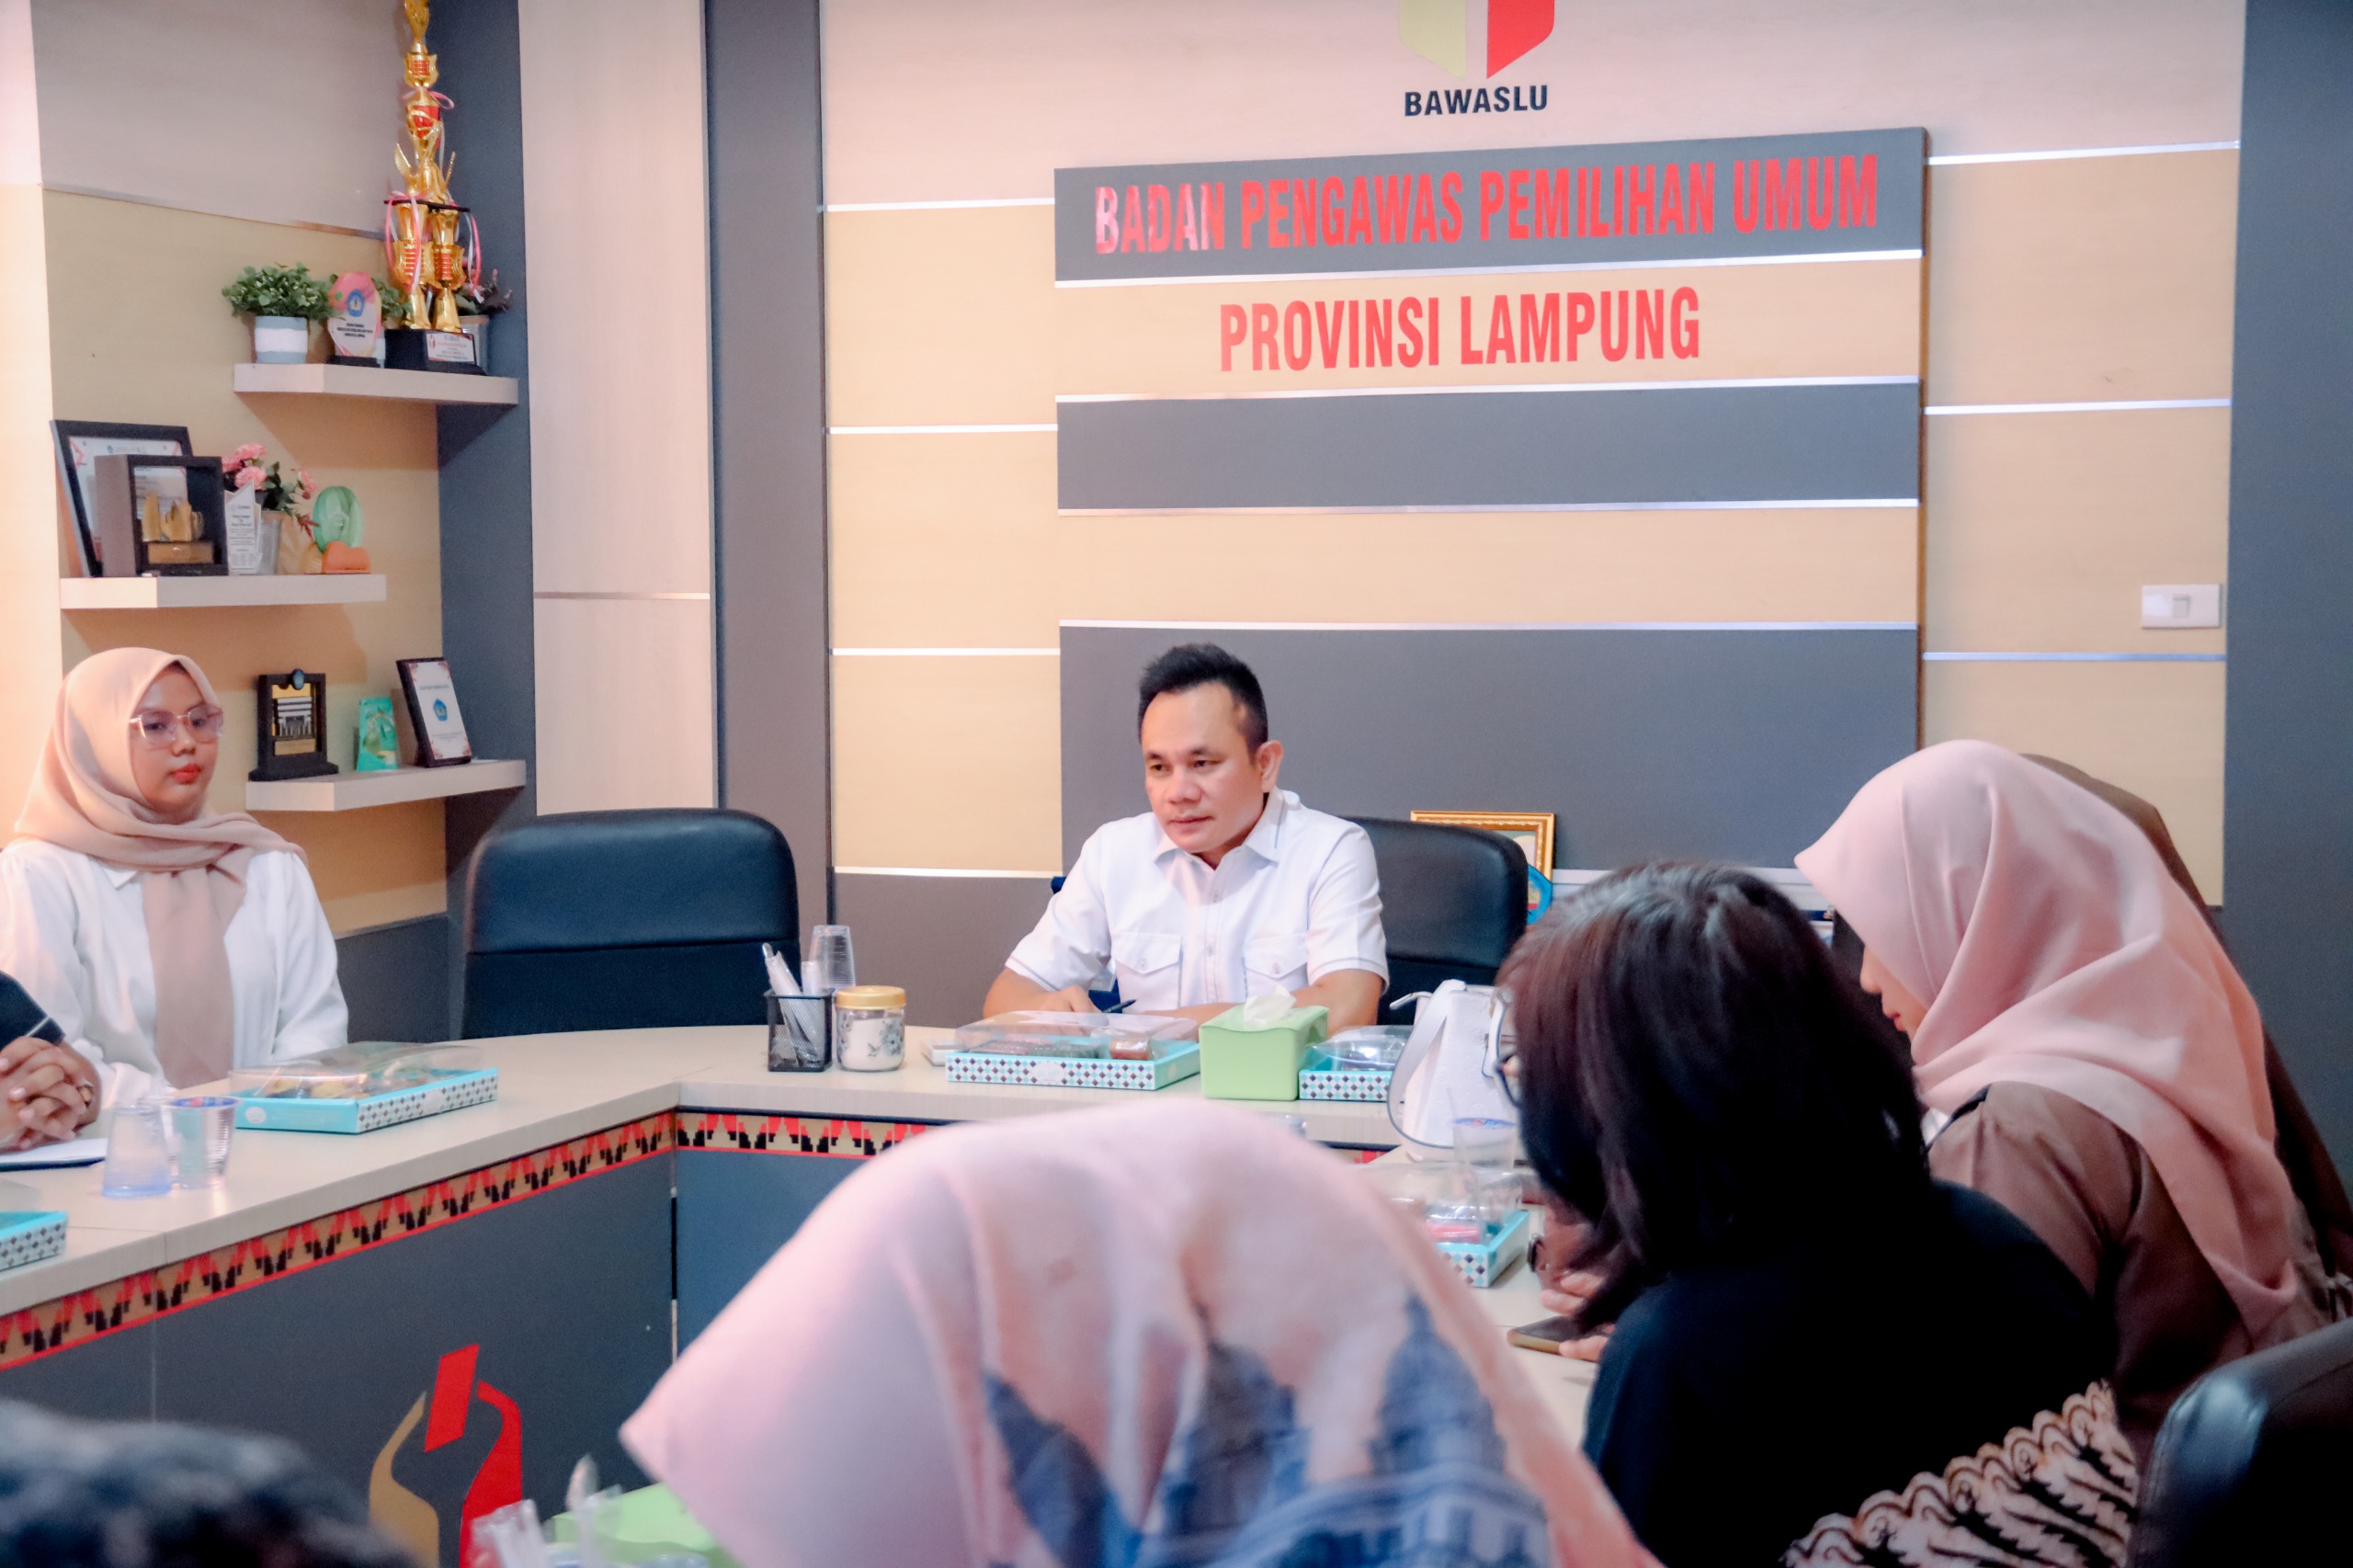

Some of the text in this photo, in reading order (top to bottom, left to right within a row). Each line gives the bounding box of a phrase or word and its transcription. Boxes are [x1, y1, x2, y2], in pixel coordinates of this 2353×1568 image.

[1404, 85, 1548, 117] BAWASLU
[1095, 153, 1878, 254] BADAN PENGAWAS PEMILIHAN UMUM
[1220, 286, 1699, 372] PROVINSI LAMPUNG
